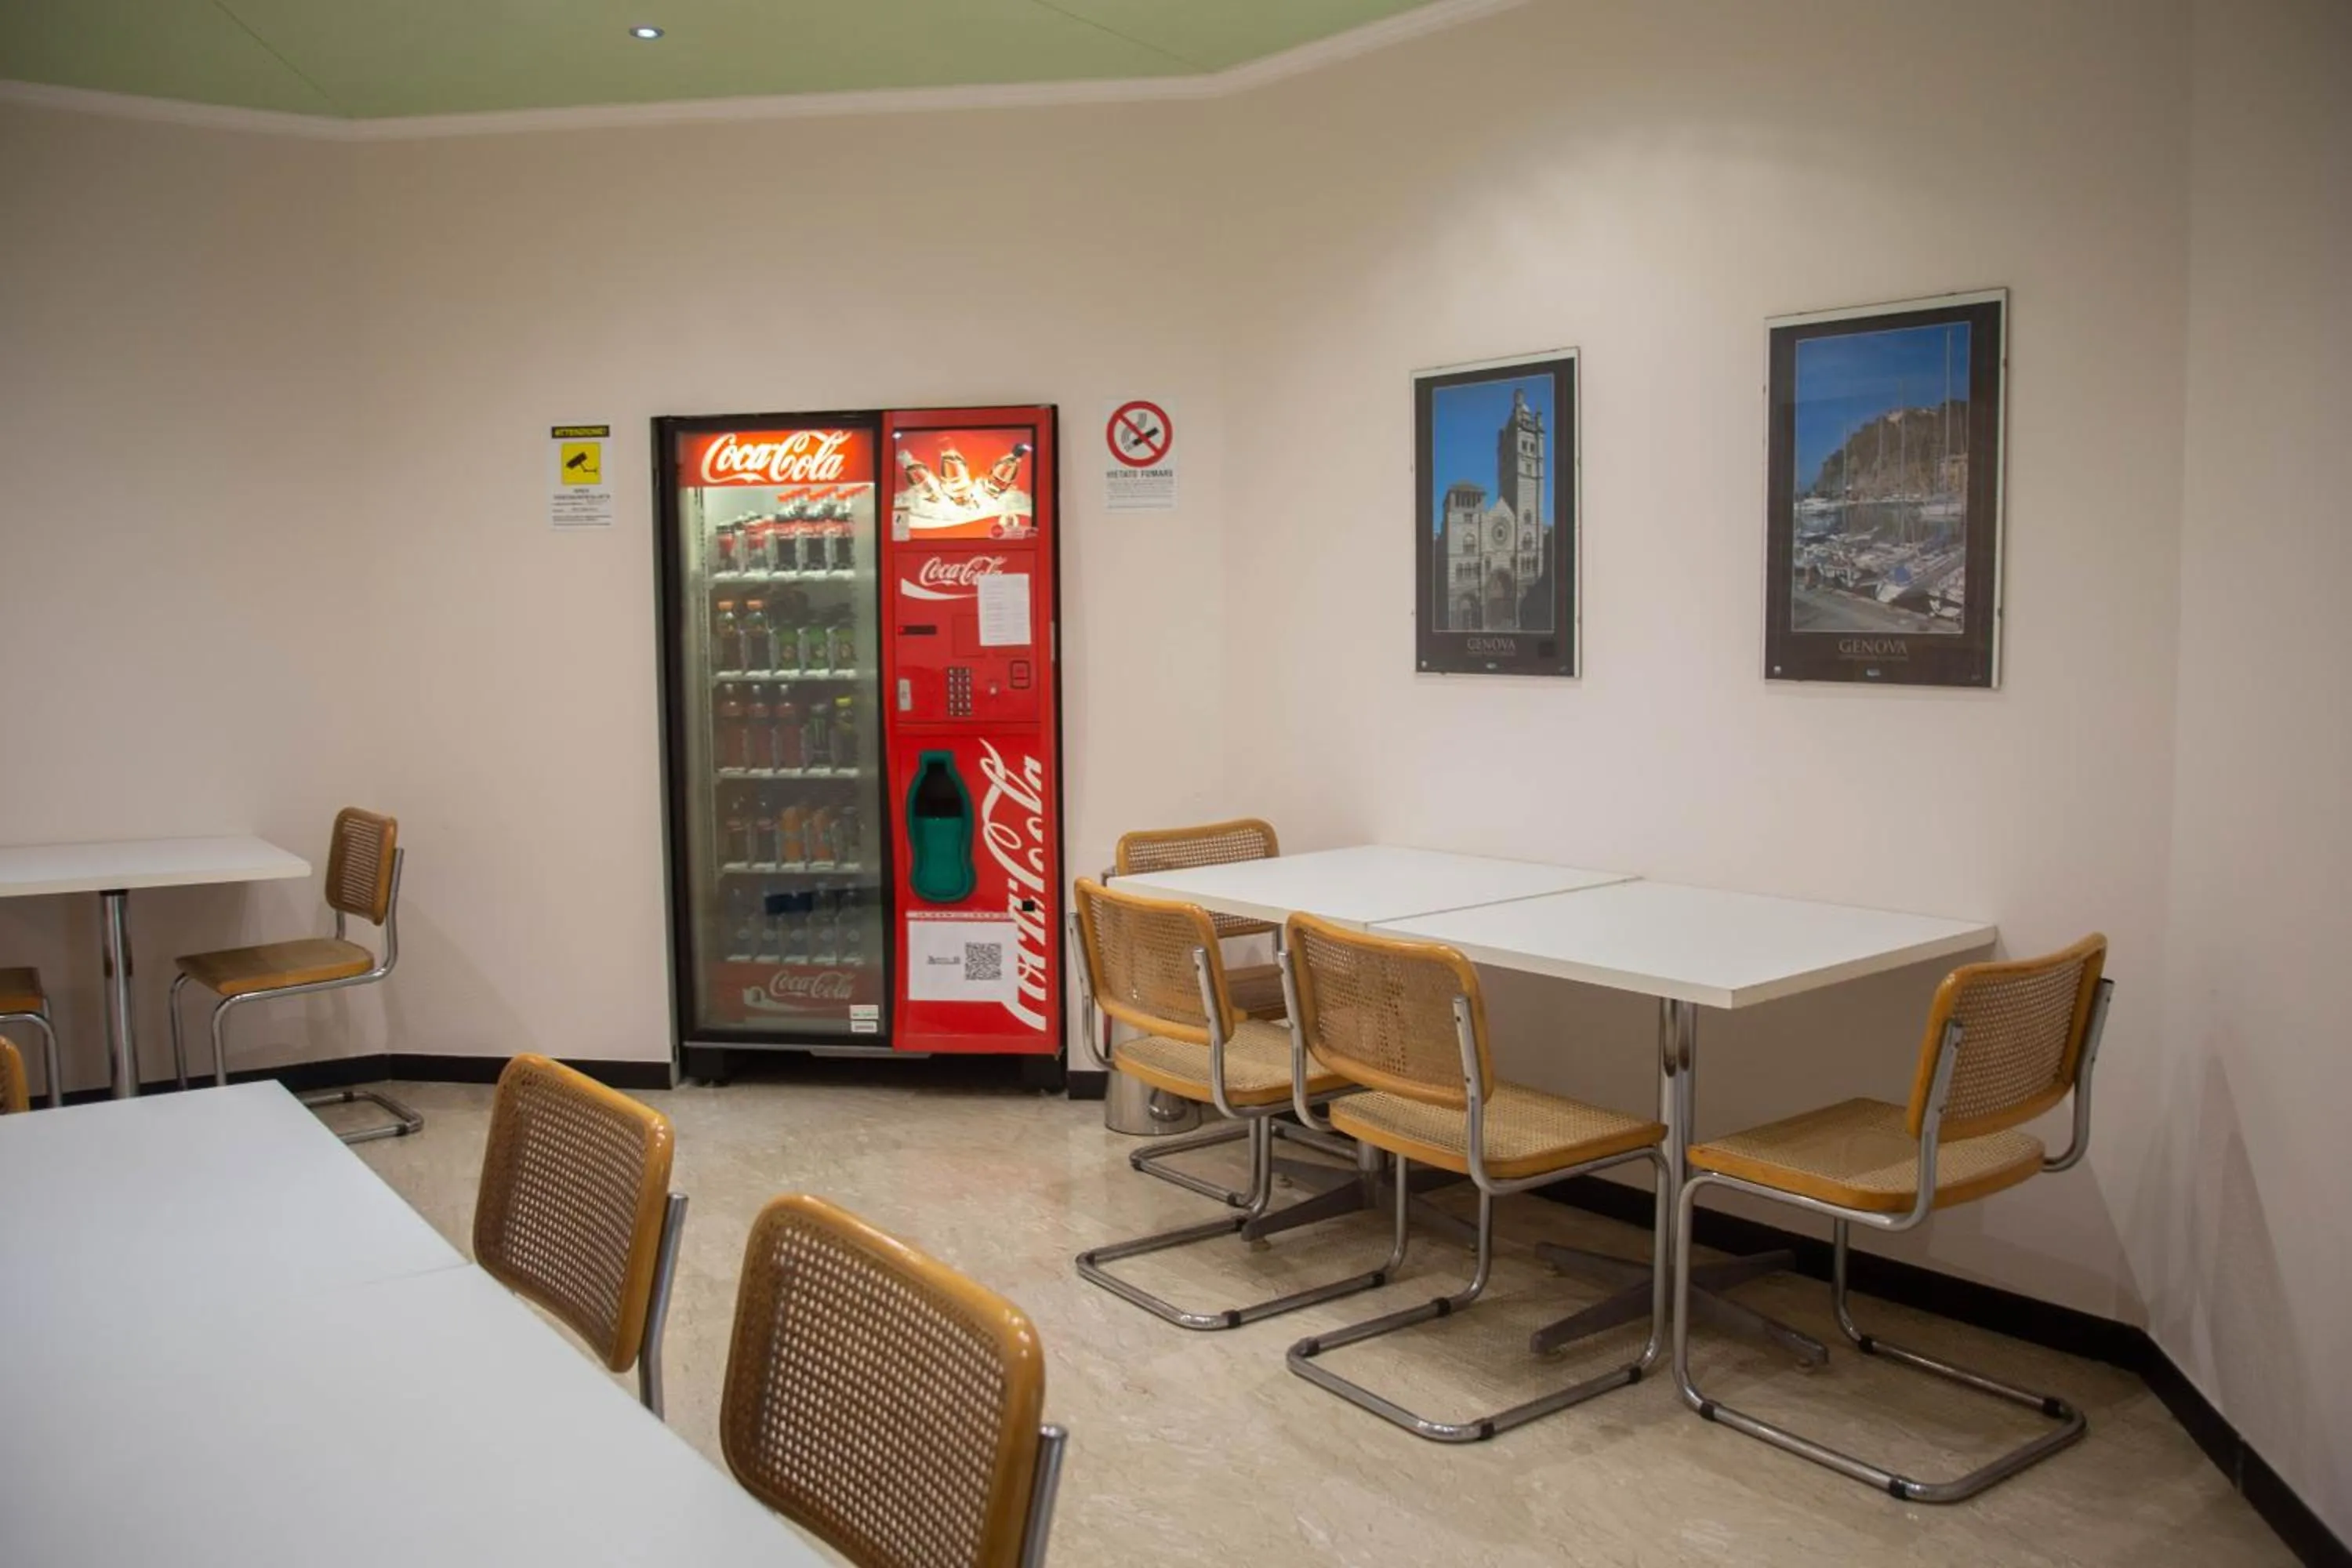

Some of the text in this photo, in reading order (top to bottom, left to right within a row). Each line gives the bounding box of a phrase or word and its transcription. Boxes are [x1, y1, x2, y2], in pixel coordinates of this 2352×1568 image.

[701, 430, 853, 483] Coca-Cola
[919, 556, 1007, 586] Coca-Cl
[1467, 637, 1516, 652] GENOVA
[1838, 638, 1907, 654] GENOVA
[769, 970, 856, 1000] Coca-Cola
